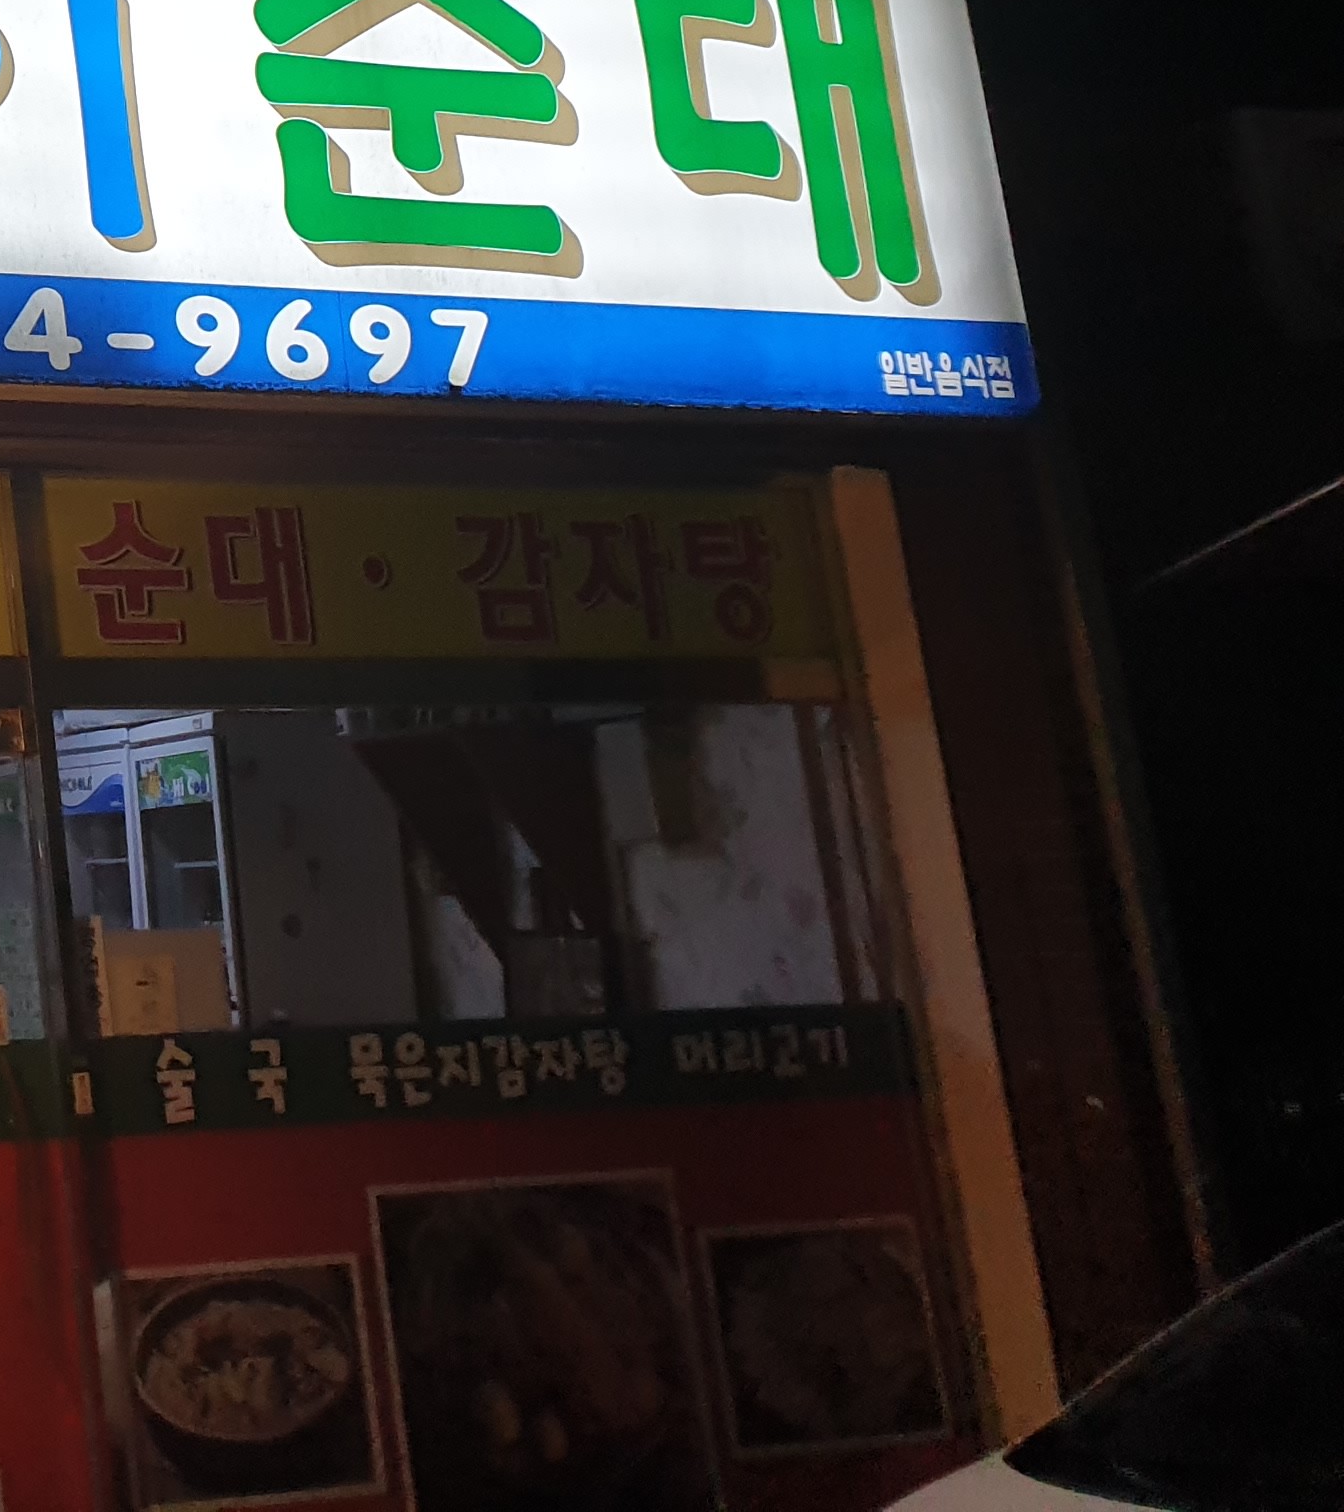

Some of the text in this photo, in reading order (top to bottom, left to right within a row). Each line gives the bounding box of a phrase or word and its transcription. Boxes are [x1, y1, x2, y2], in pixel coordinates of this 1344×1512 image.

[879, 350, 1016, 399] 일반음식점
[76, 499, 313, 645] 순대
[455, 509, 779, 645] 감자탕
[347, 1026, 632, 1110] 묵은지감자탕
[672, 1023, 851, 1076] 머리고기
